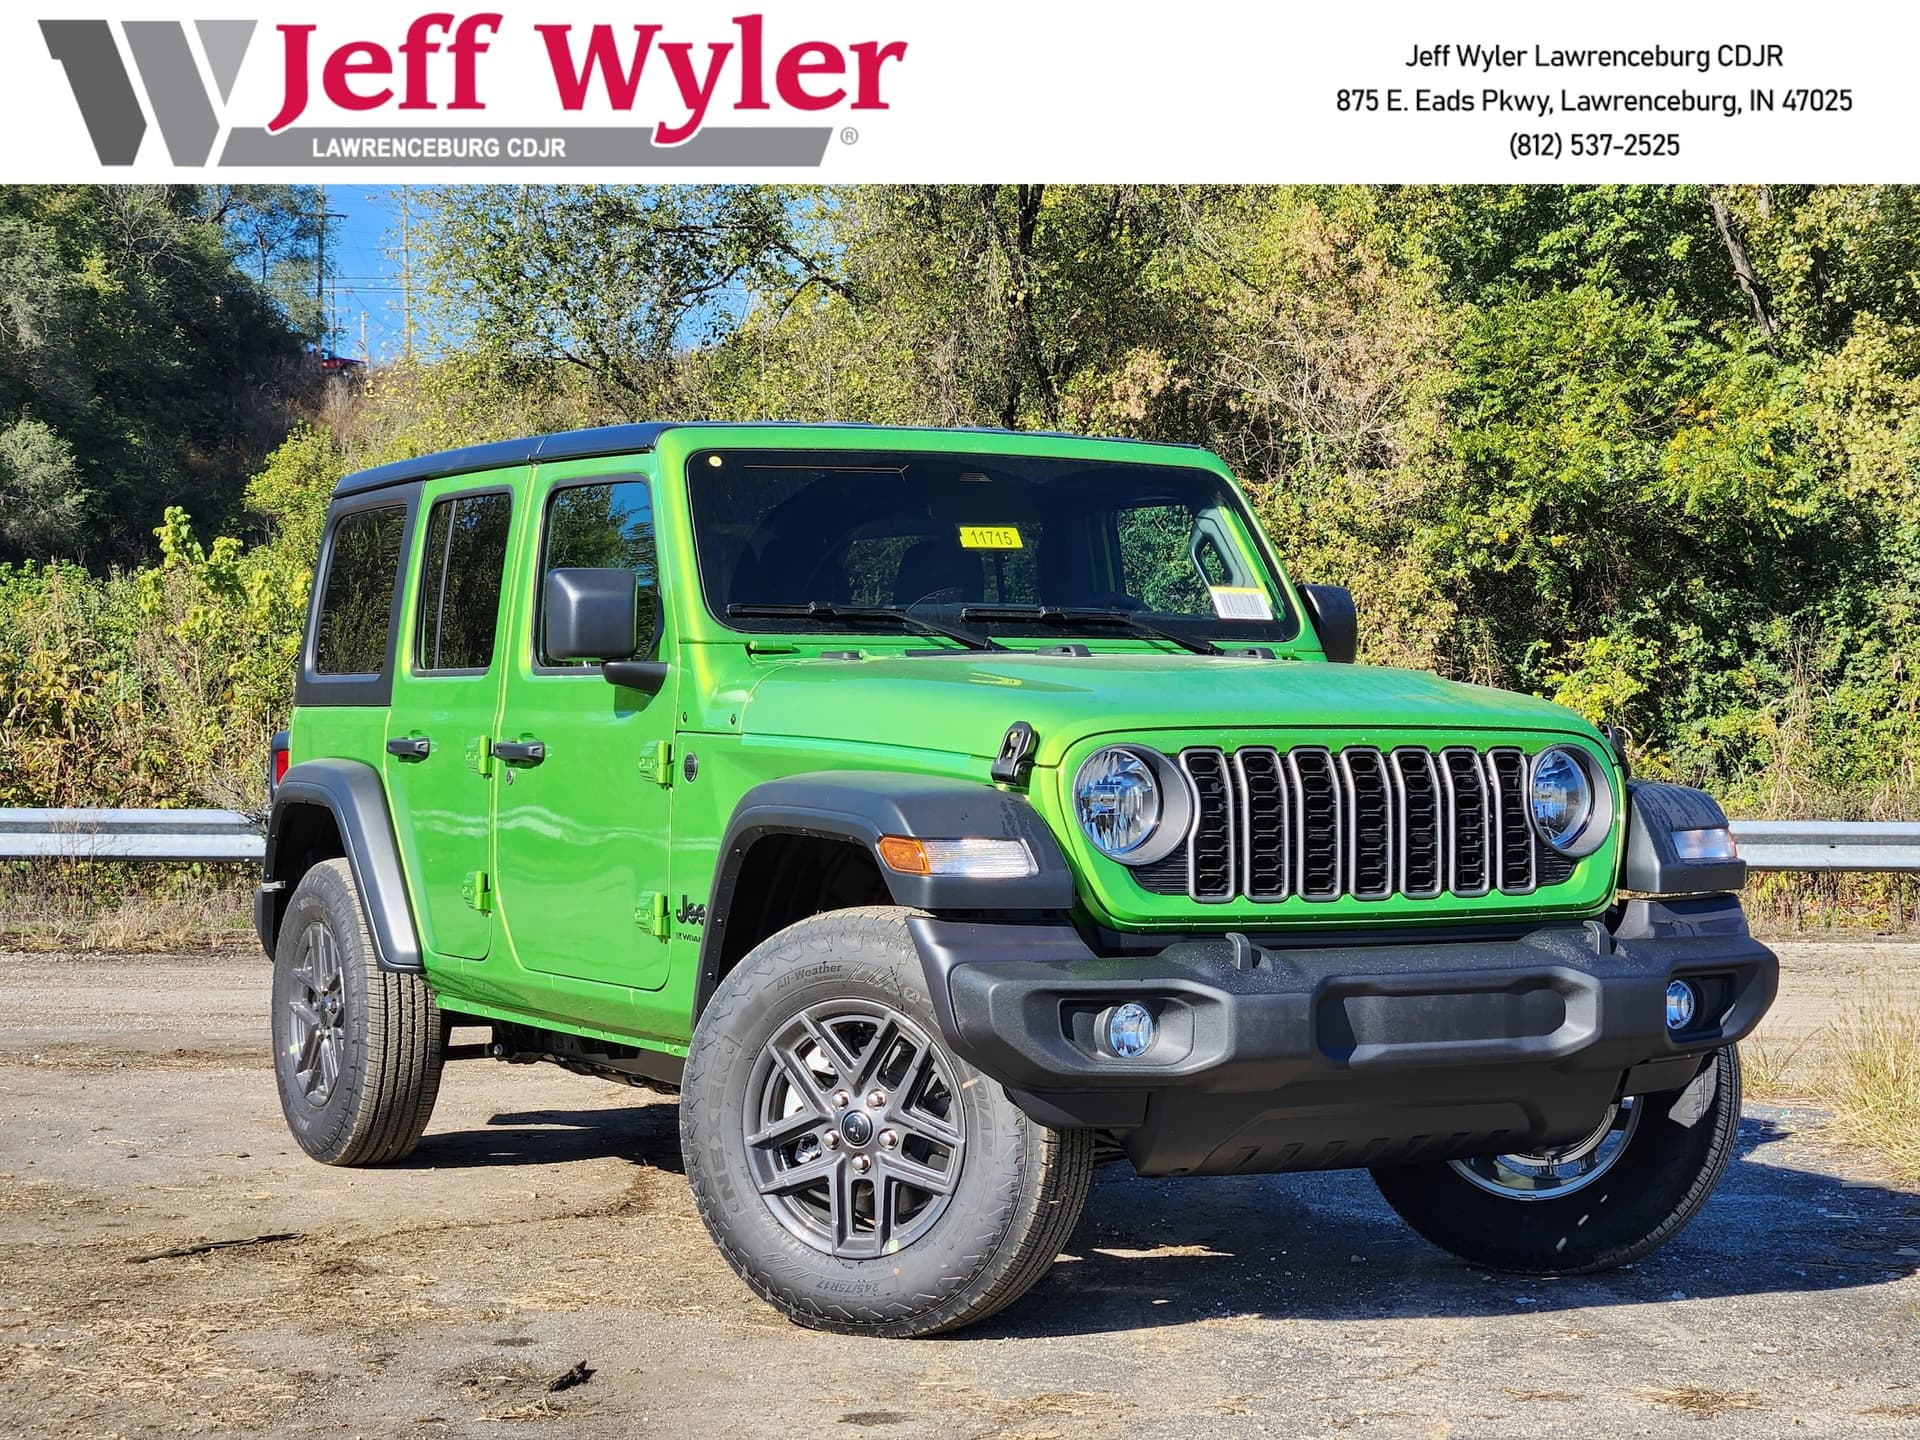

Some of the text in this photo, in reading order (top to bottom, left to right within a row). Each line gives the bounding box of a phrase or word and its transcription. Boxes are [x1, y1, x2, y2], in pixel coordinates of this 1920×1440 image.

[971, 530, 1012, 545] 11715
[676, 895, 707, 926] Jee
[777, 961, 843, 991] All-Weather
